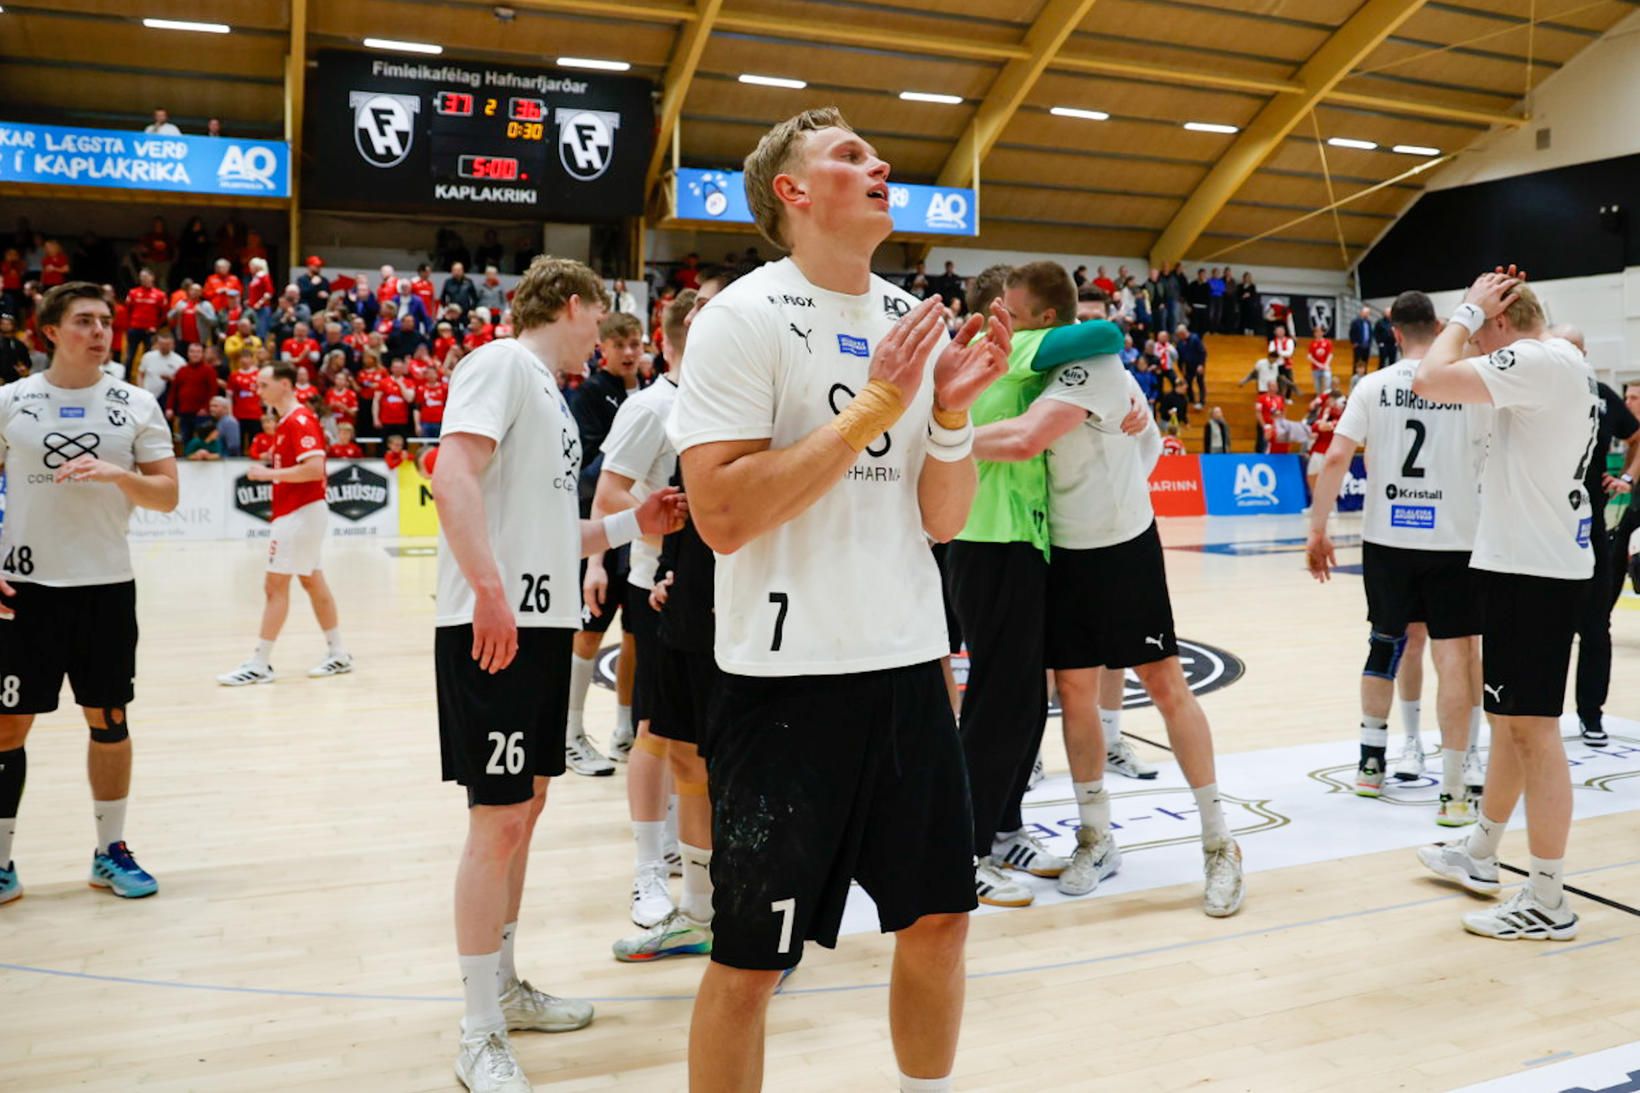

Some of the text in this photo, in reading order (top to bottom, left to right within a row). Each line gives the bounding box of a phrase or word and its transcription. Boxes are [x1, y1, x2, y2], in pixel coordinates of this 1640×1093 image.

[372, 60, 588, 94] Fimleikafélag Hafnarfjarðar
[484, 98, 498, 116] 2
[507, 121, 544, 139] 0:30
[435, 184, 537, 203] KAPLAKRIKI
[1401, 419, 1426, 478] 2
[1399, 488, 1442, 500] Kristall
[519, 573, 551, 614] 26
[769, 592, 789, 652] 7
[0, 674, 21, 708] 8
[486, 731, 525, 775] 26
